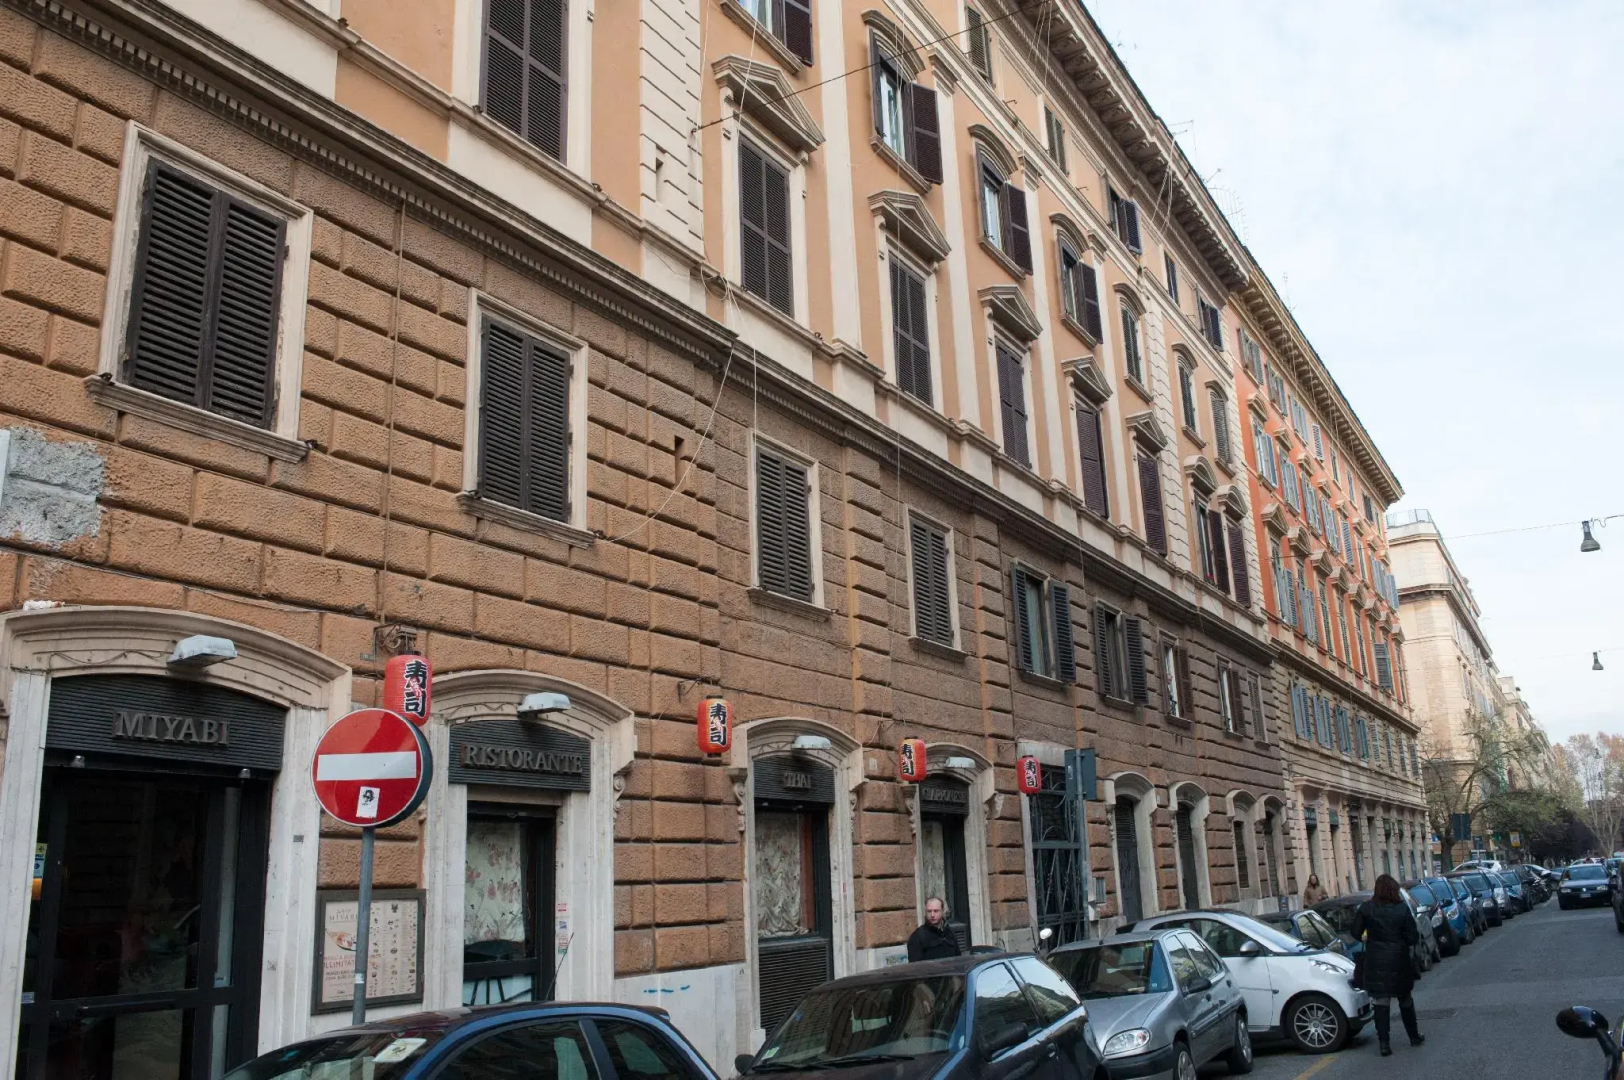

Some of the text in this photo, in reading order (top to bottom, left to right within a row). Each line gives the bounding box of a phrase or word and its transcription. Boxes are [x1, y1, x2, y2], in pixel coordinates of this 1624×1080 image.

[113, 710, 230, 745] MIYABI
[464, 744, 583, 774] RISTORANTE
[785, 772, 813, 789] THAI
